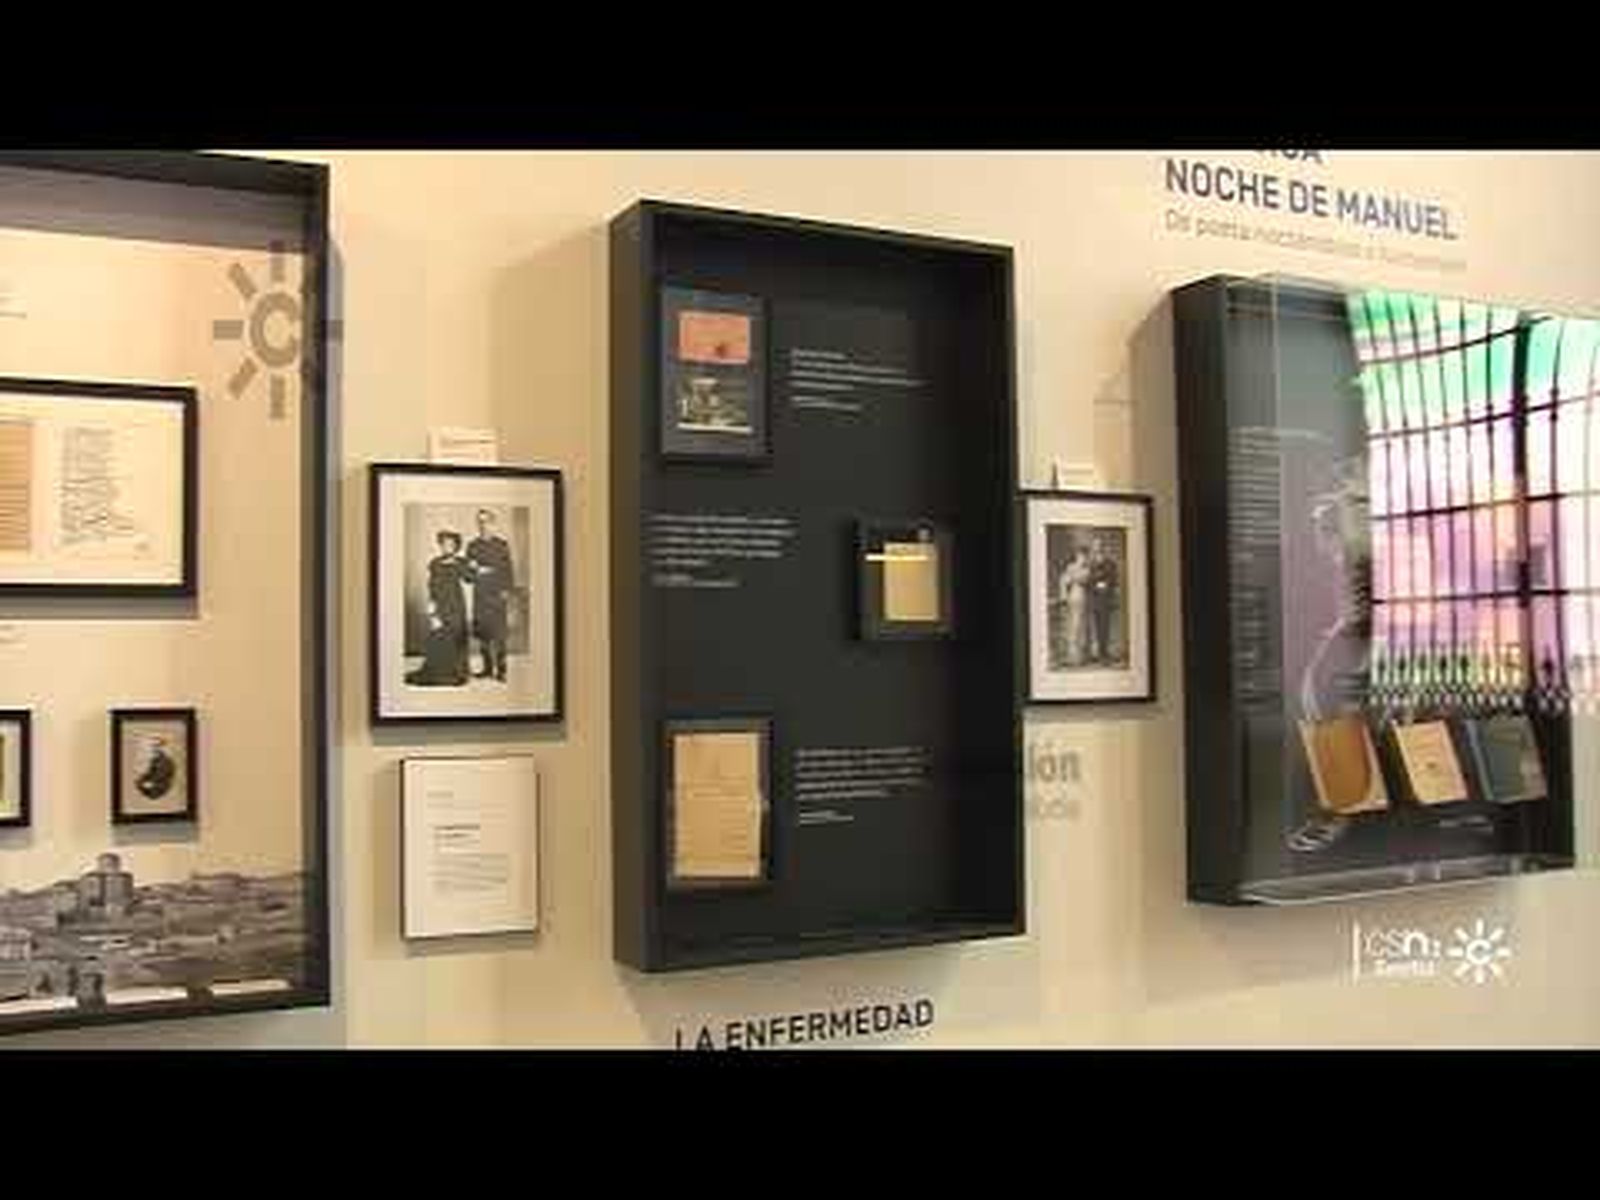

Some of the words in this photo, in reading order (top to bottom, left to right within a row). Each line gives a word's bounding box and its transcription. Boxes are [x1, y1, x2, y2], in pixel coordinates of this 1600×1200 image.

[1165, 158, 1282, 209] NOCHE
[1288, 180, 1329, 216] DE
[1336, 191, 1458, 241] MANUEL
[726, 999, 934, 1049] ENFERMEDAD
